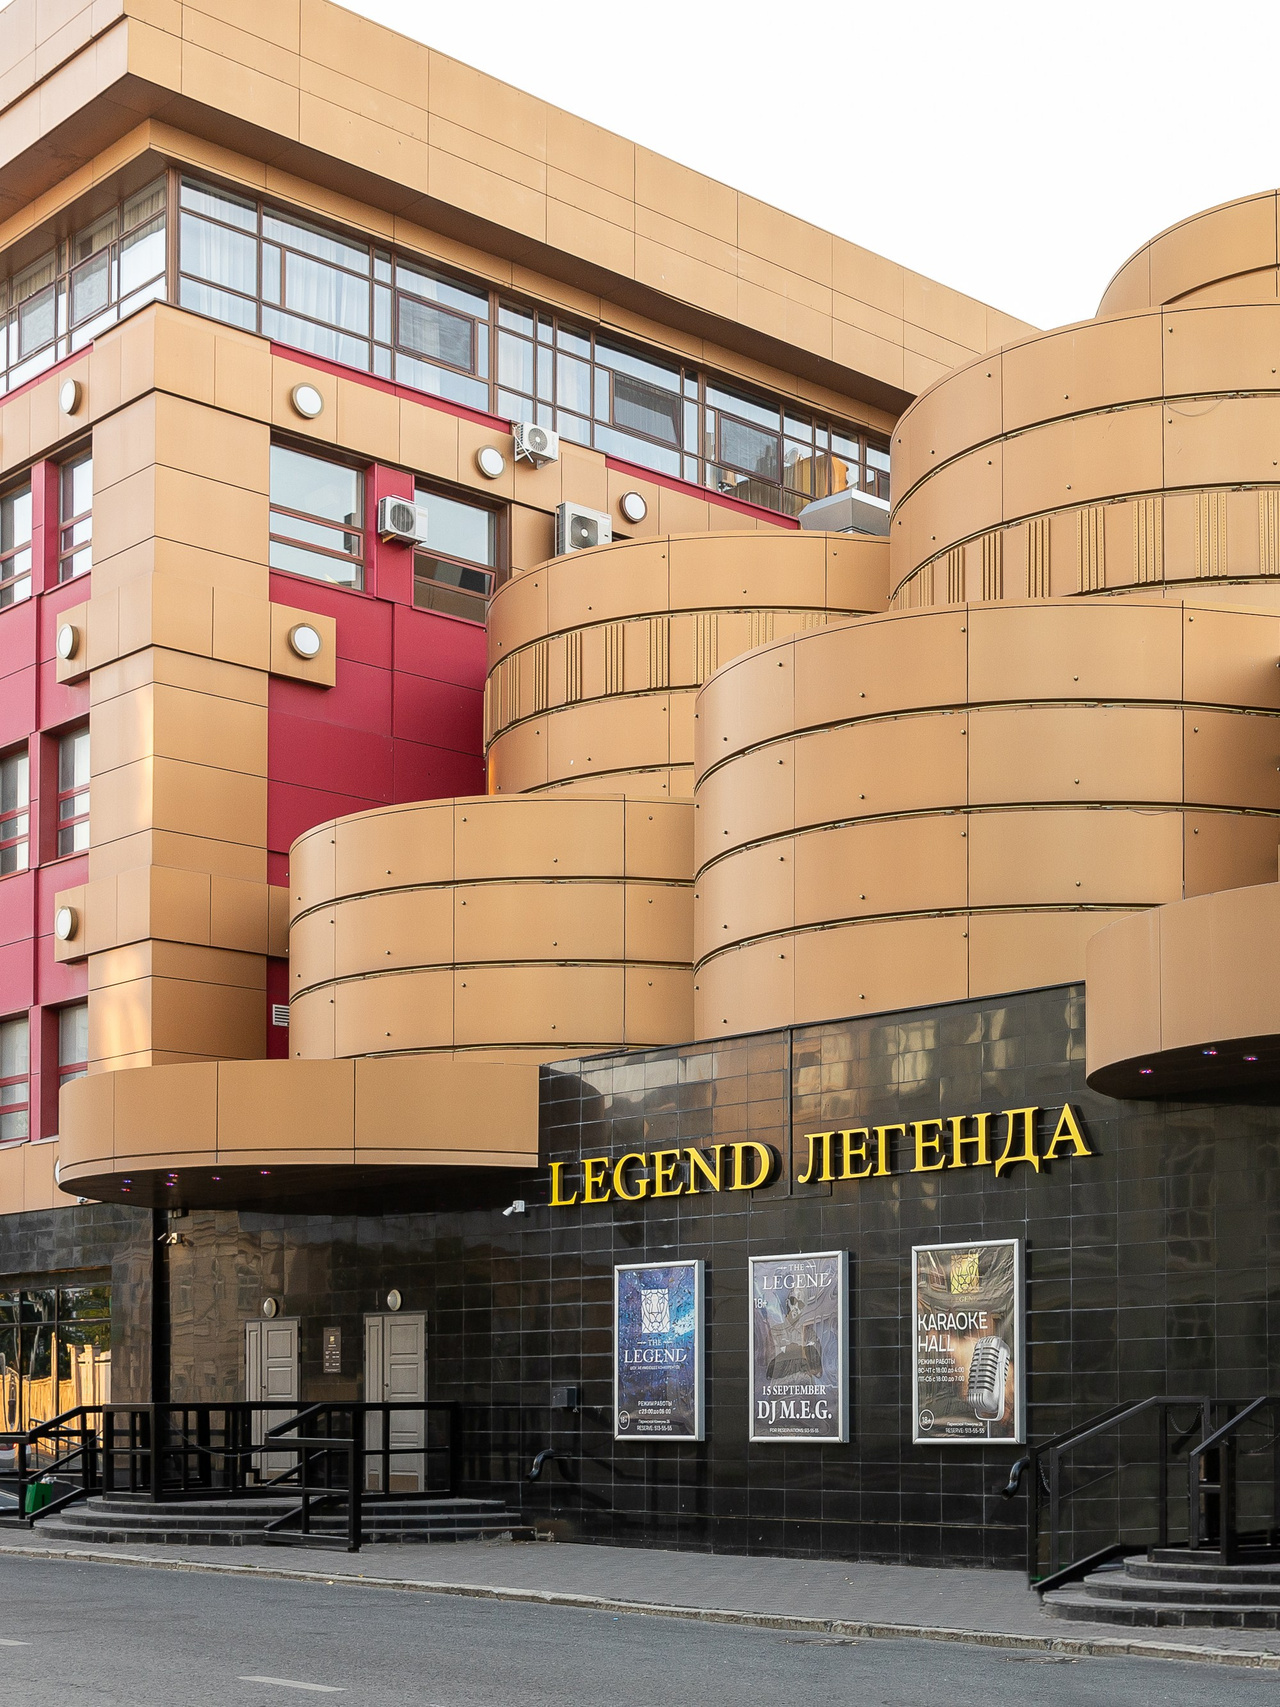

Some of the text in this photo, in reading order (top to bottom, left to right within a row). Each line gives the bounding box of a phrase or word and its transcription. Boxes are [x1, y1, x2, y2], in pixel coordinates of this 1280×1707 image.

[797, 1102, 1092, 1183] ЛЕГЕНДА
[548, 1141, 772, 1207] LEGEND
[789, 1263, 805, 1271] THE
[762, 1272, 832, 1290] LEGEND
[753, 1298, 768, 1309] 18+
[917, 1311, 988, 1331] KARAOKE
[917, 1334, 955, 1353] HALL
[624, 1349, 687, 1363] LEGEND
[762, 1385, 826, 1396] 15 SEPTEMBER
[757, 1400, 832, 1424] DJ M.E.G.
[921, 1416, 932, 1424] 18+
